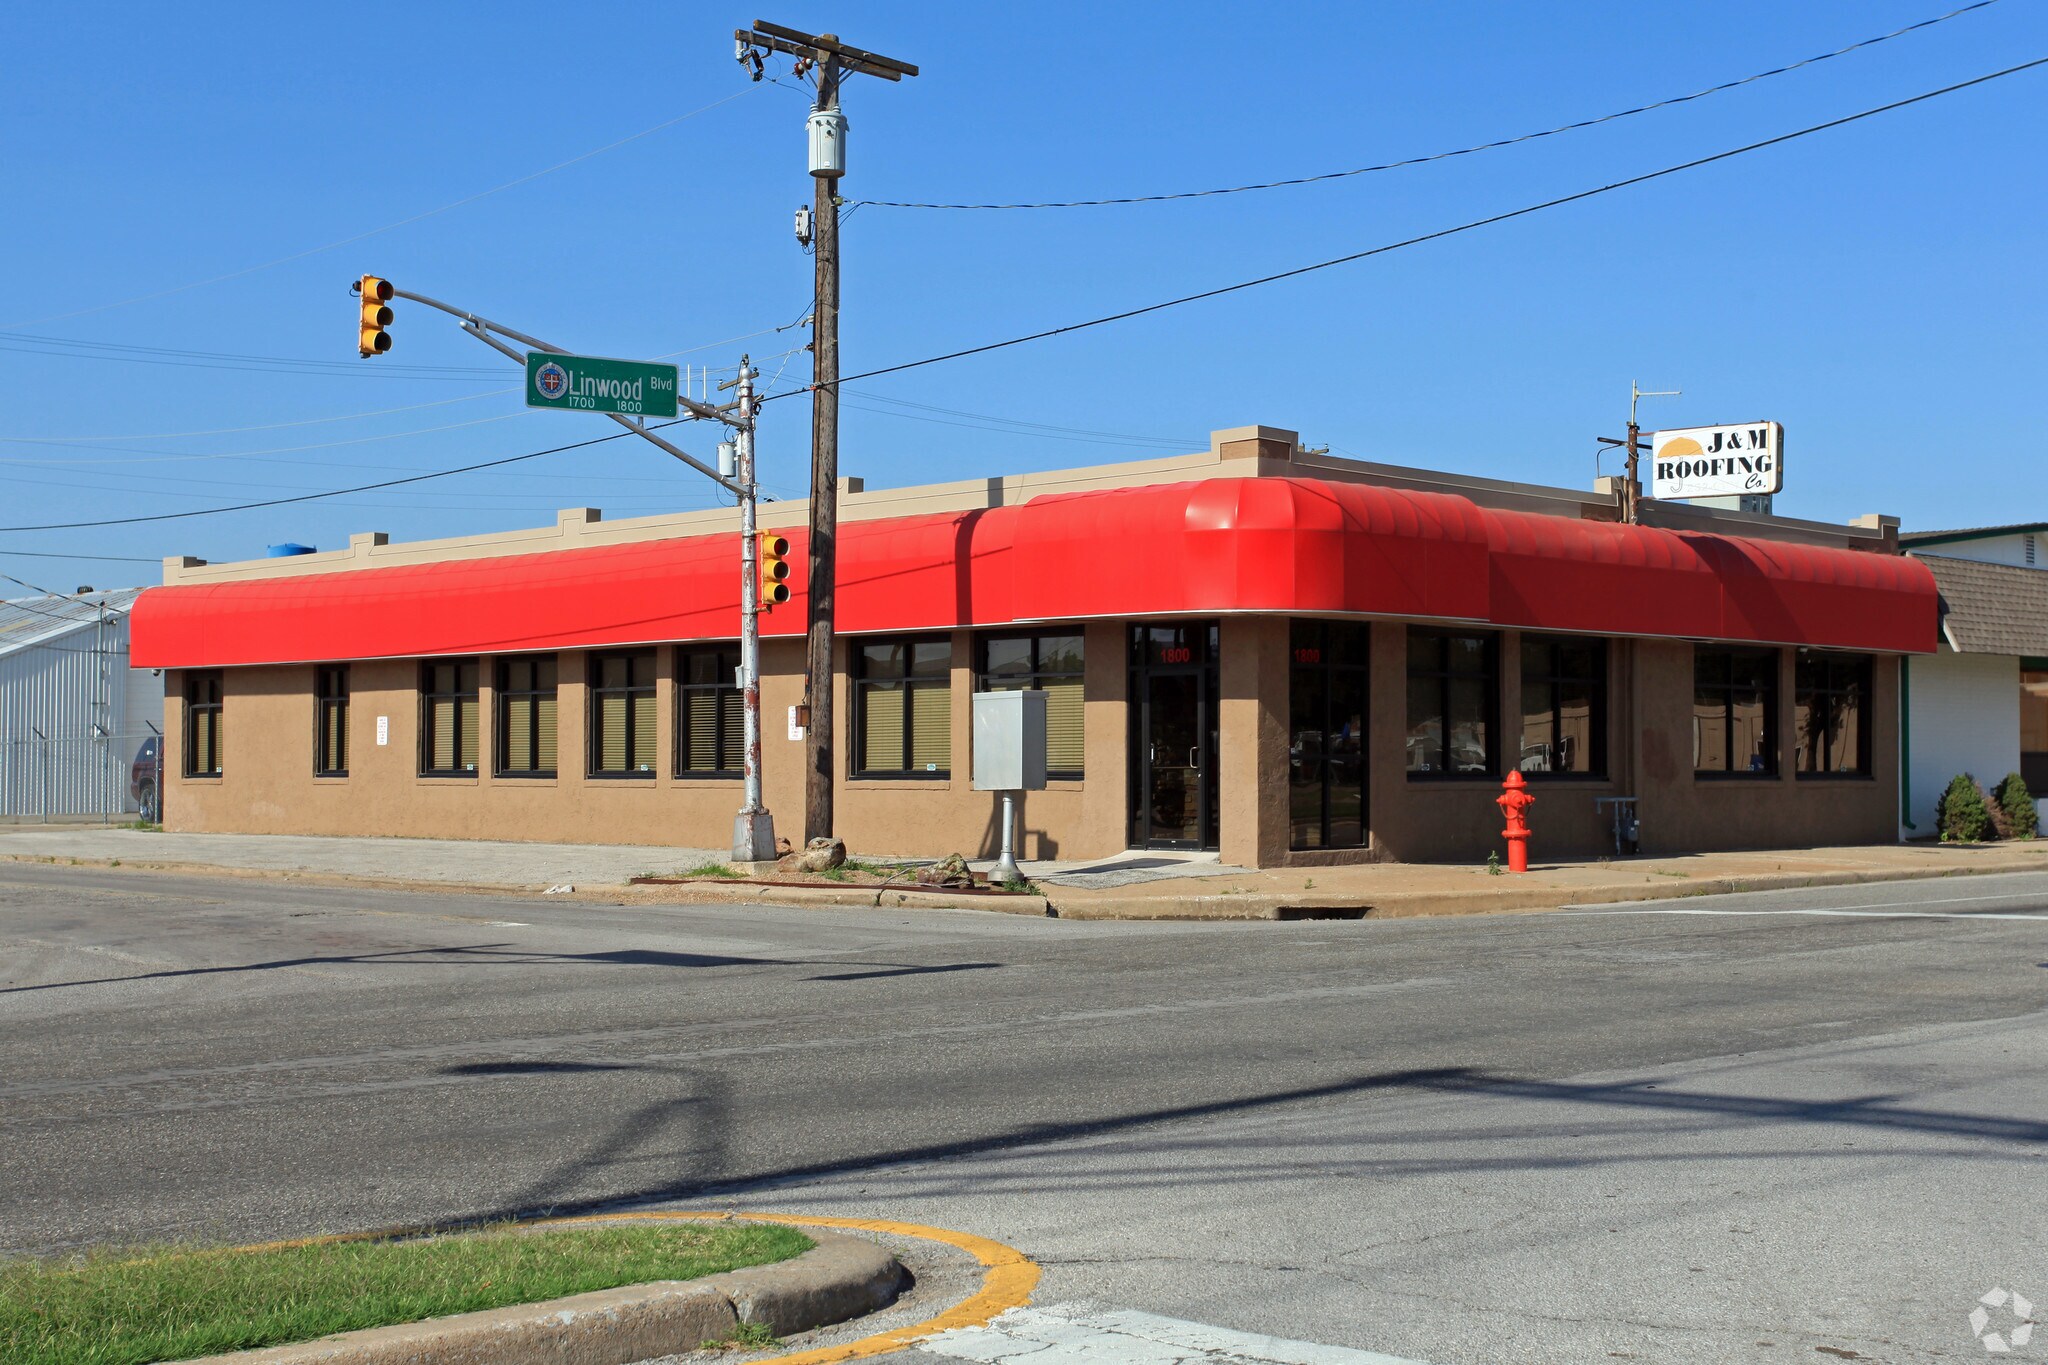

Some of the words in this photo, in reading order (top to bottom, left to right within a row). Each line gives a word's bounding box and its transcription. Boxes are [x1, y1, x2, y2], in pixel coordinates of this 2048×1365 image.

[569, 370, 642, 401] Linwood
[650, 376, 672, 391] Blvd
[569, 396, 595, 409] 1700
[617, 401, 642, 413] 1800
[1656, 454, 1773, 480] ROOFING
[1745, 473, 1767, 489] Co.
[1160, 647, 1190, 664] 1800
